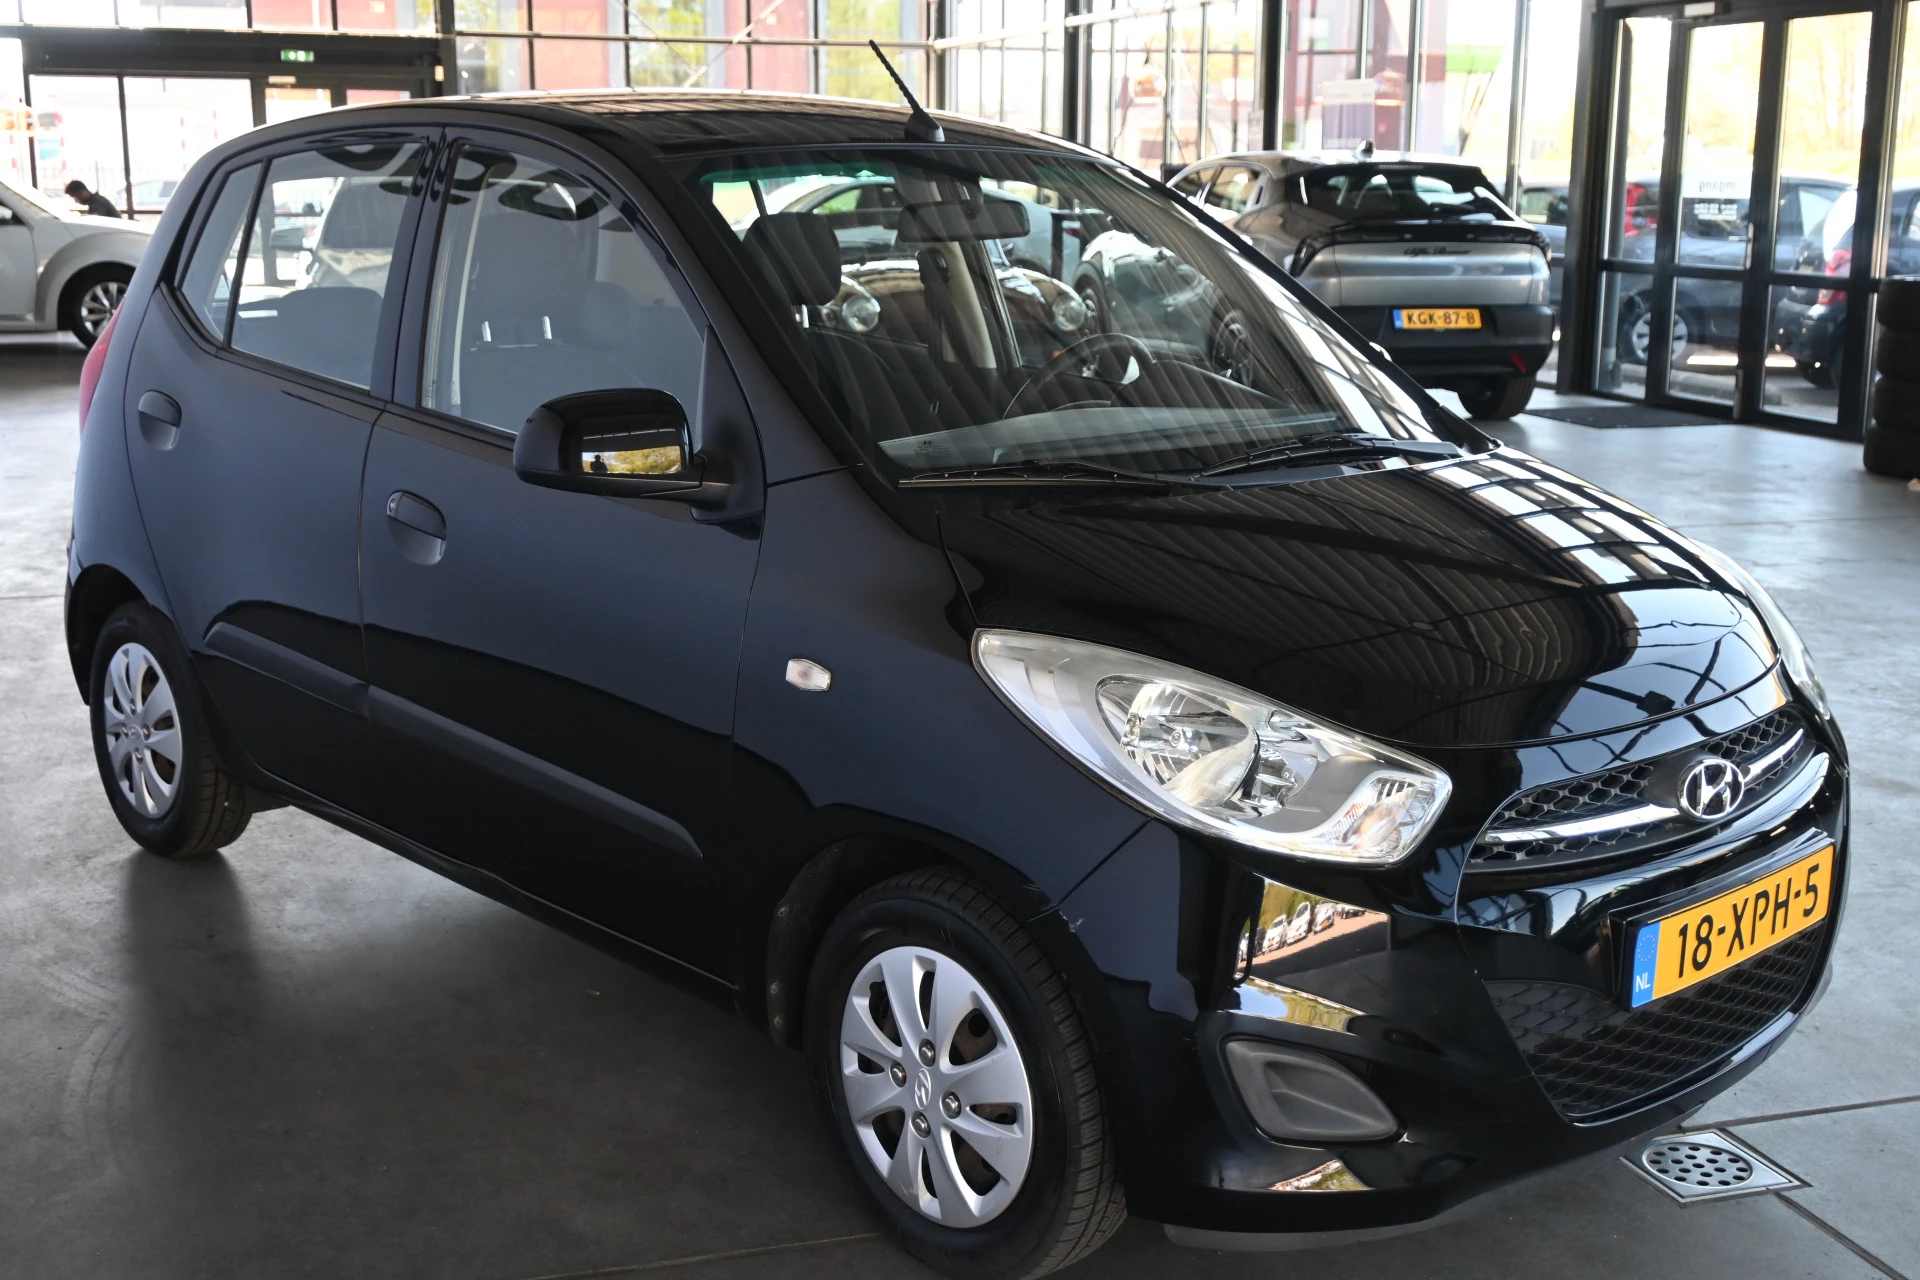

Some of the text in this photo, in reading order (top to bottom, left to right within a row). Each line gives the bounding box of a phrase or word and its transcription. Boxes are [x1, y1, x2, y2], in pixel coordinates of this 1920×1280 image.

[1407, 311, 1475, 325] KGK-87-B
[1678, 863, 1820, 979] 18-XPH-5
[1635, 971, 1651, 993] NL
